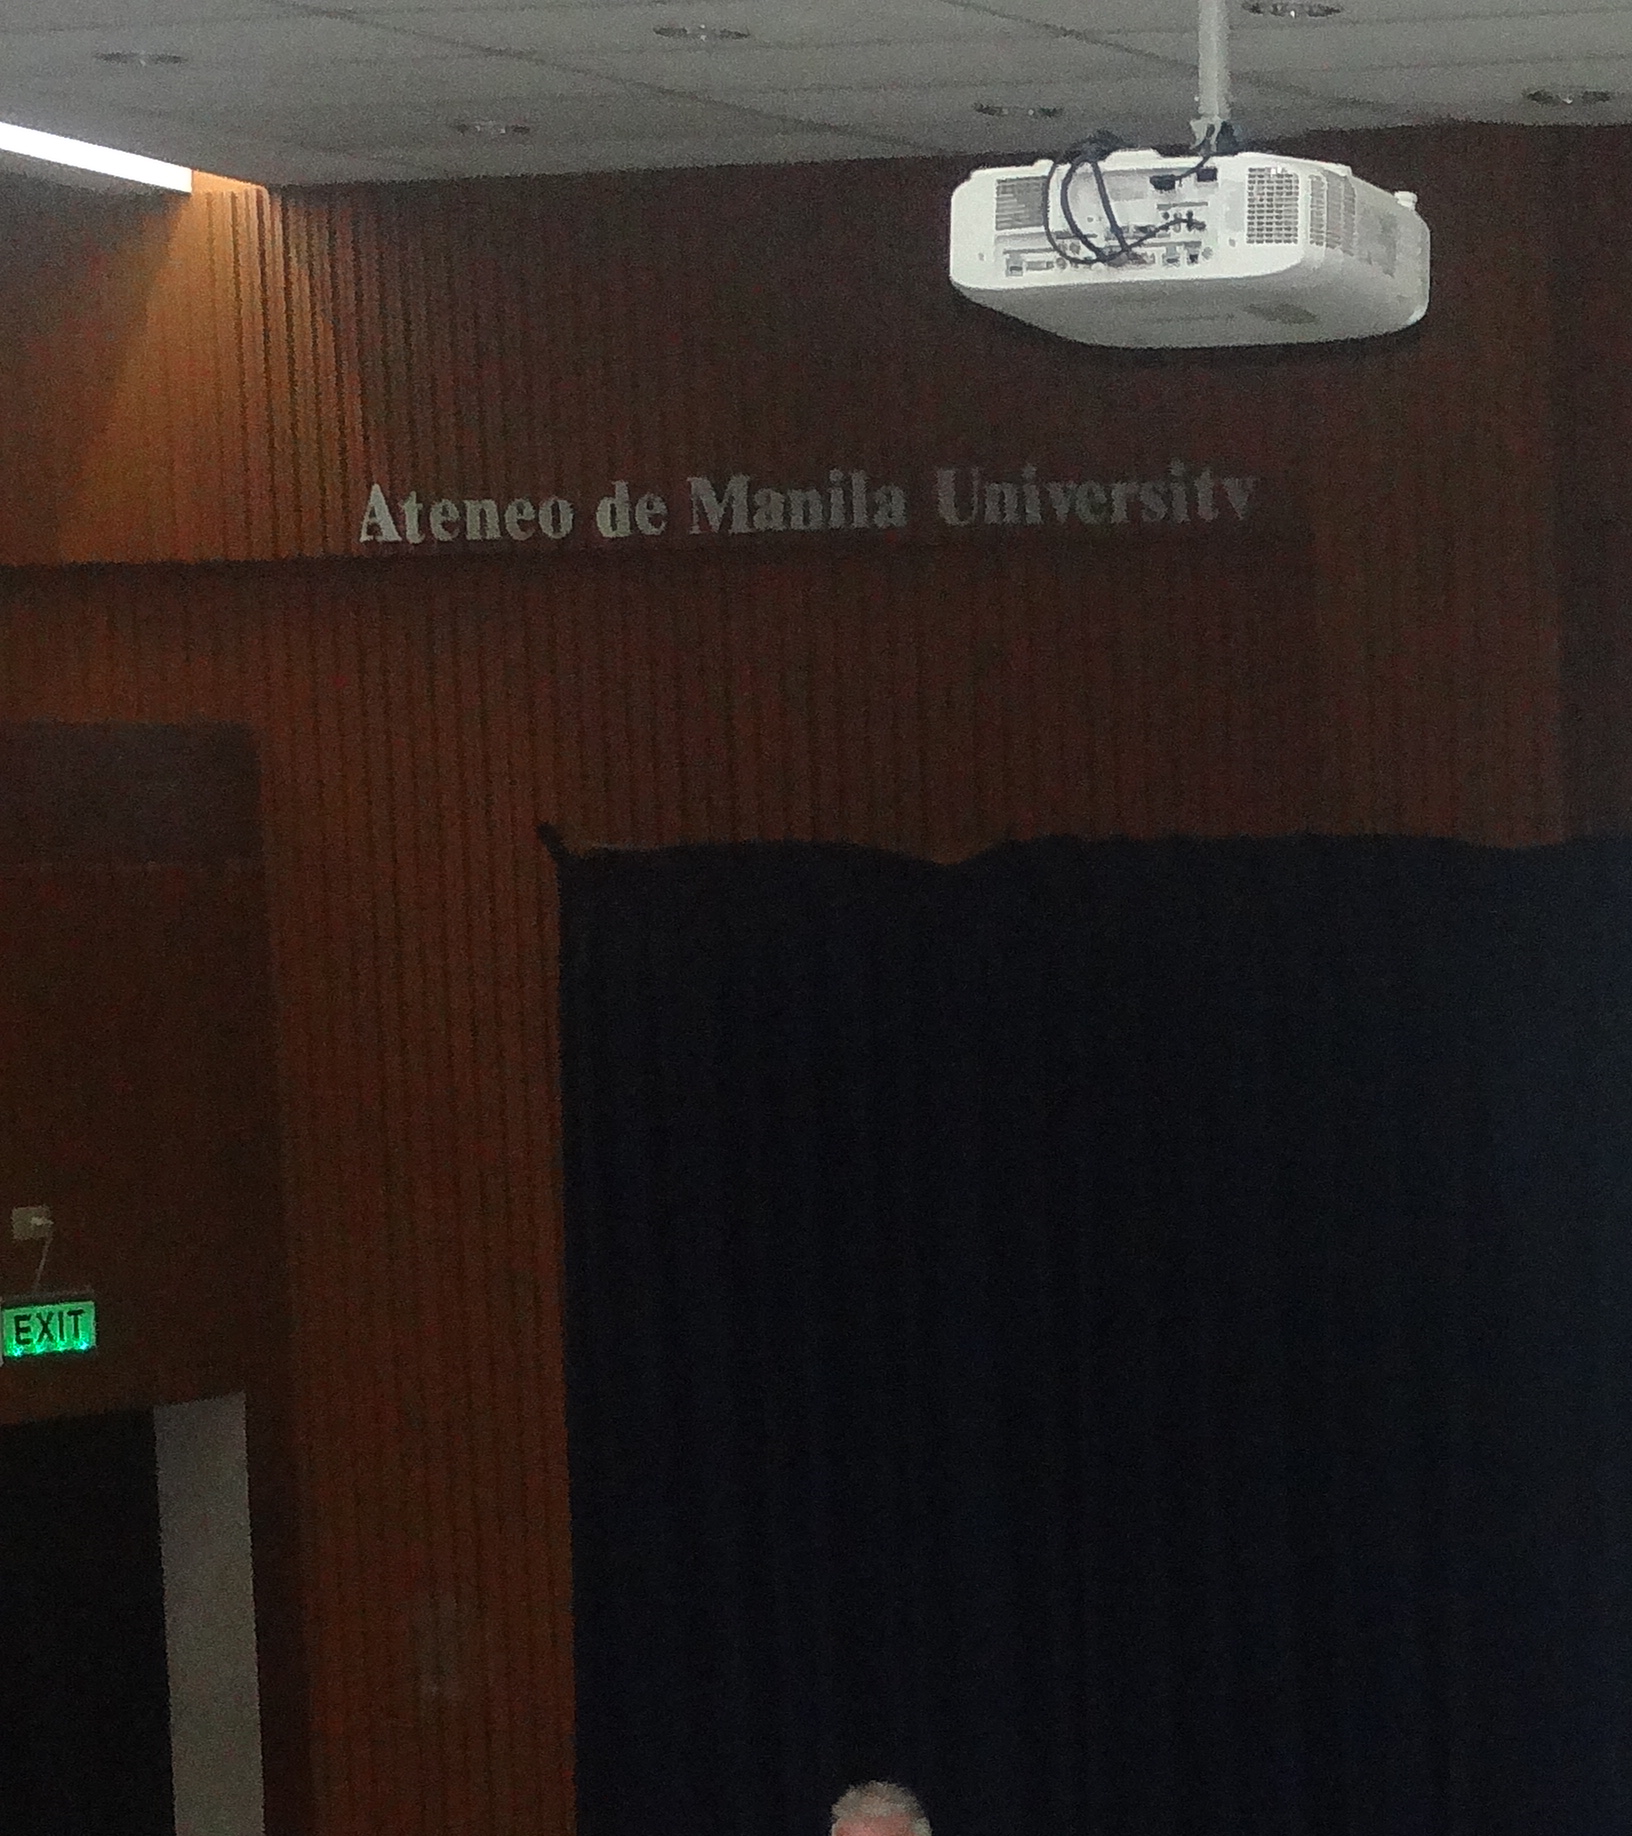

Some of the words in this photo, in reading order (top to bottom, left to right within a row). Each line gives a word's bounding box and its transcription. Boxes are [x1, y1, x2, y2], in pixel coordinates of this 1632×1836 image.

[360, 483, 574, 543] Ateneo
[595, 480, 668, 538] de
[687, 468, 907, 535] Manila
[935, 458, 1259, 528] University
[13, 1308, 86, 1346] EXIT
